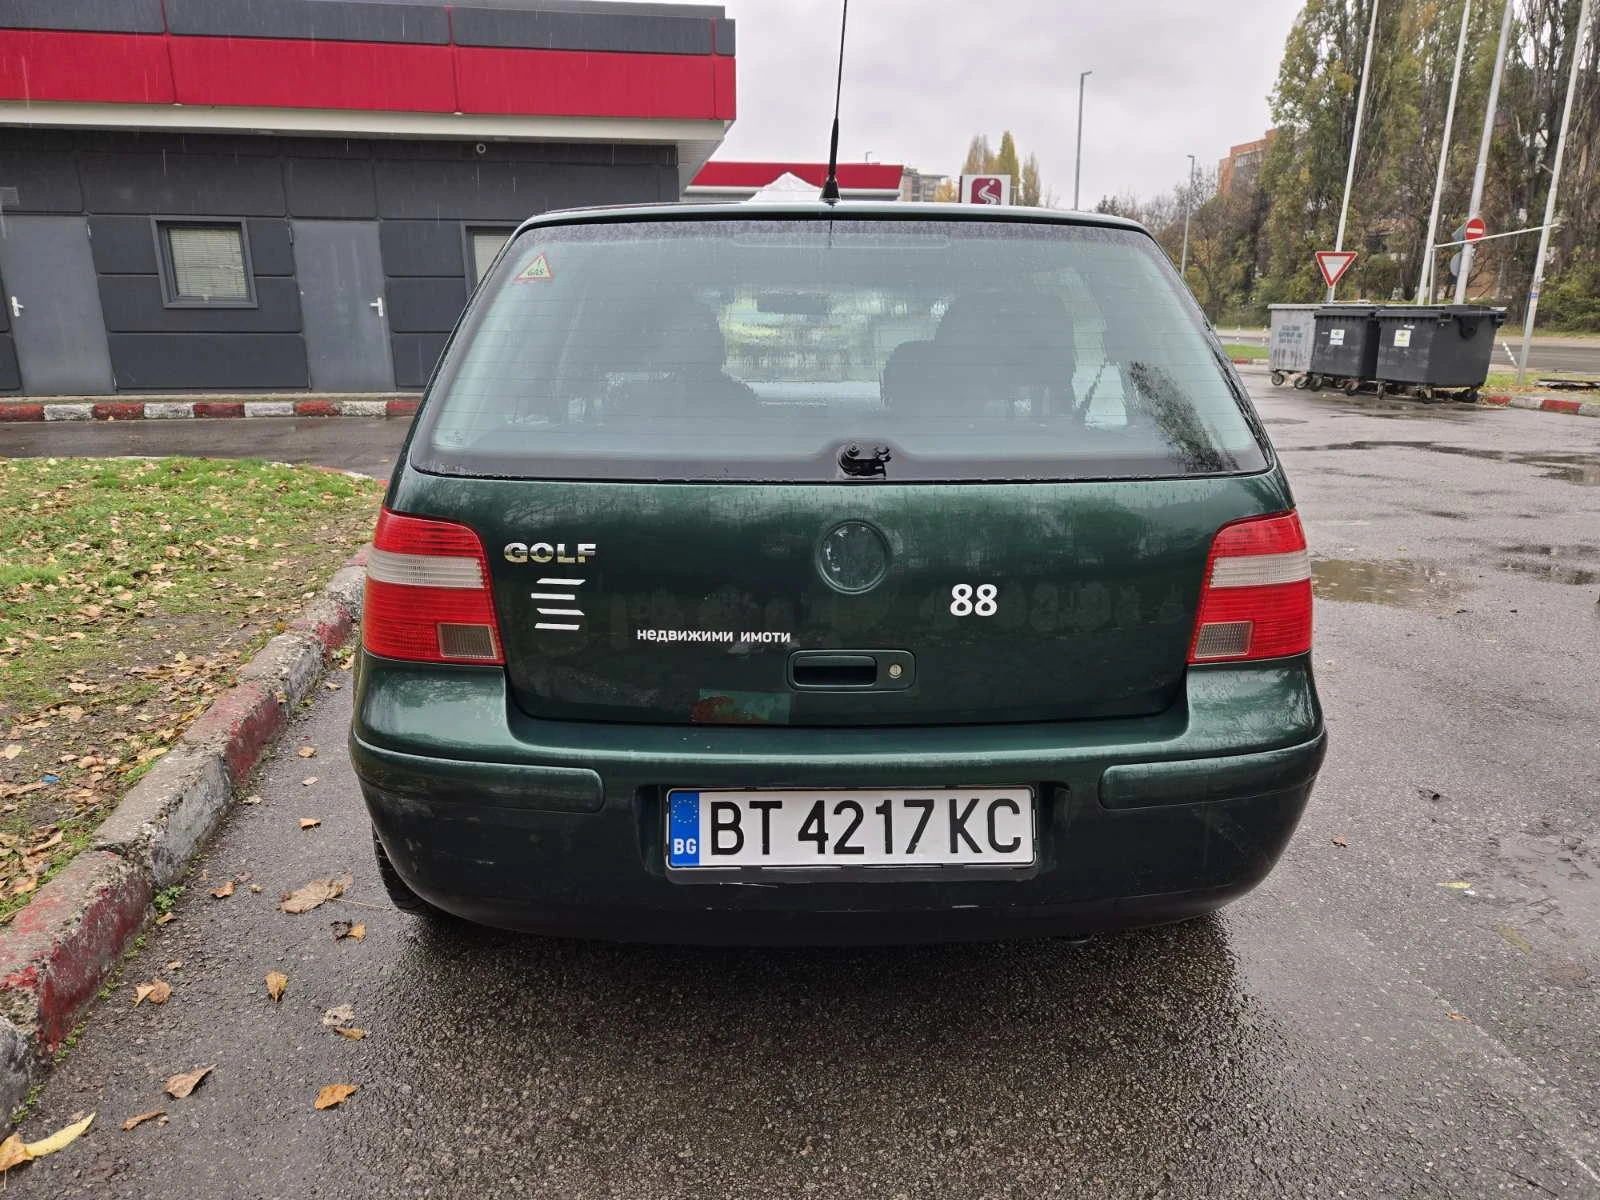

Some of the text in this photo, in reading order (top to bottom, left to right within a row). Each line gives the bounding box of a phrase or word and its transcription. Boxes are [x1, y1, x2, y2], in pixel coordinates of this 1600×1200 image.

[504, 542, 596, 564] GOLF
[950, 583, 998, 617] 88
[637, 628, 791, 643] недвижими имоти
[711, 798, 1021, 855] BT 4217 KC
[673, 838, 697, 855] BG
